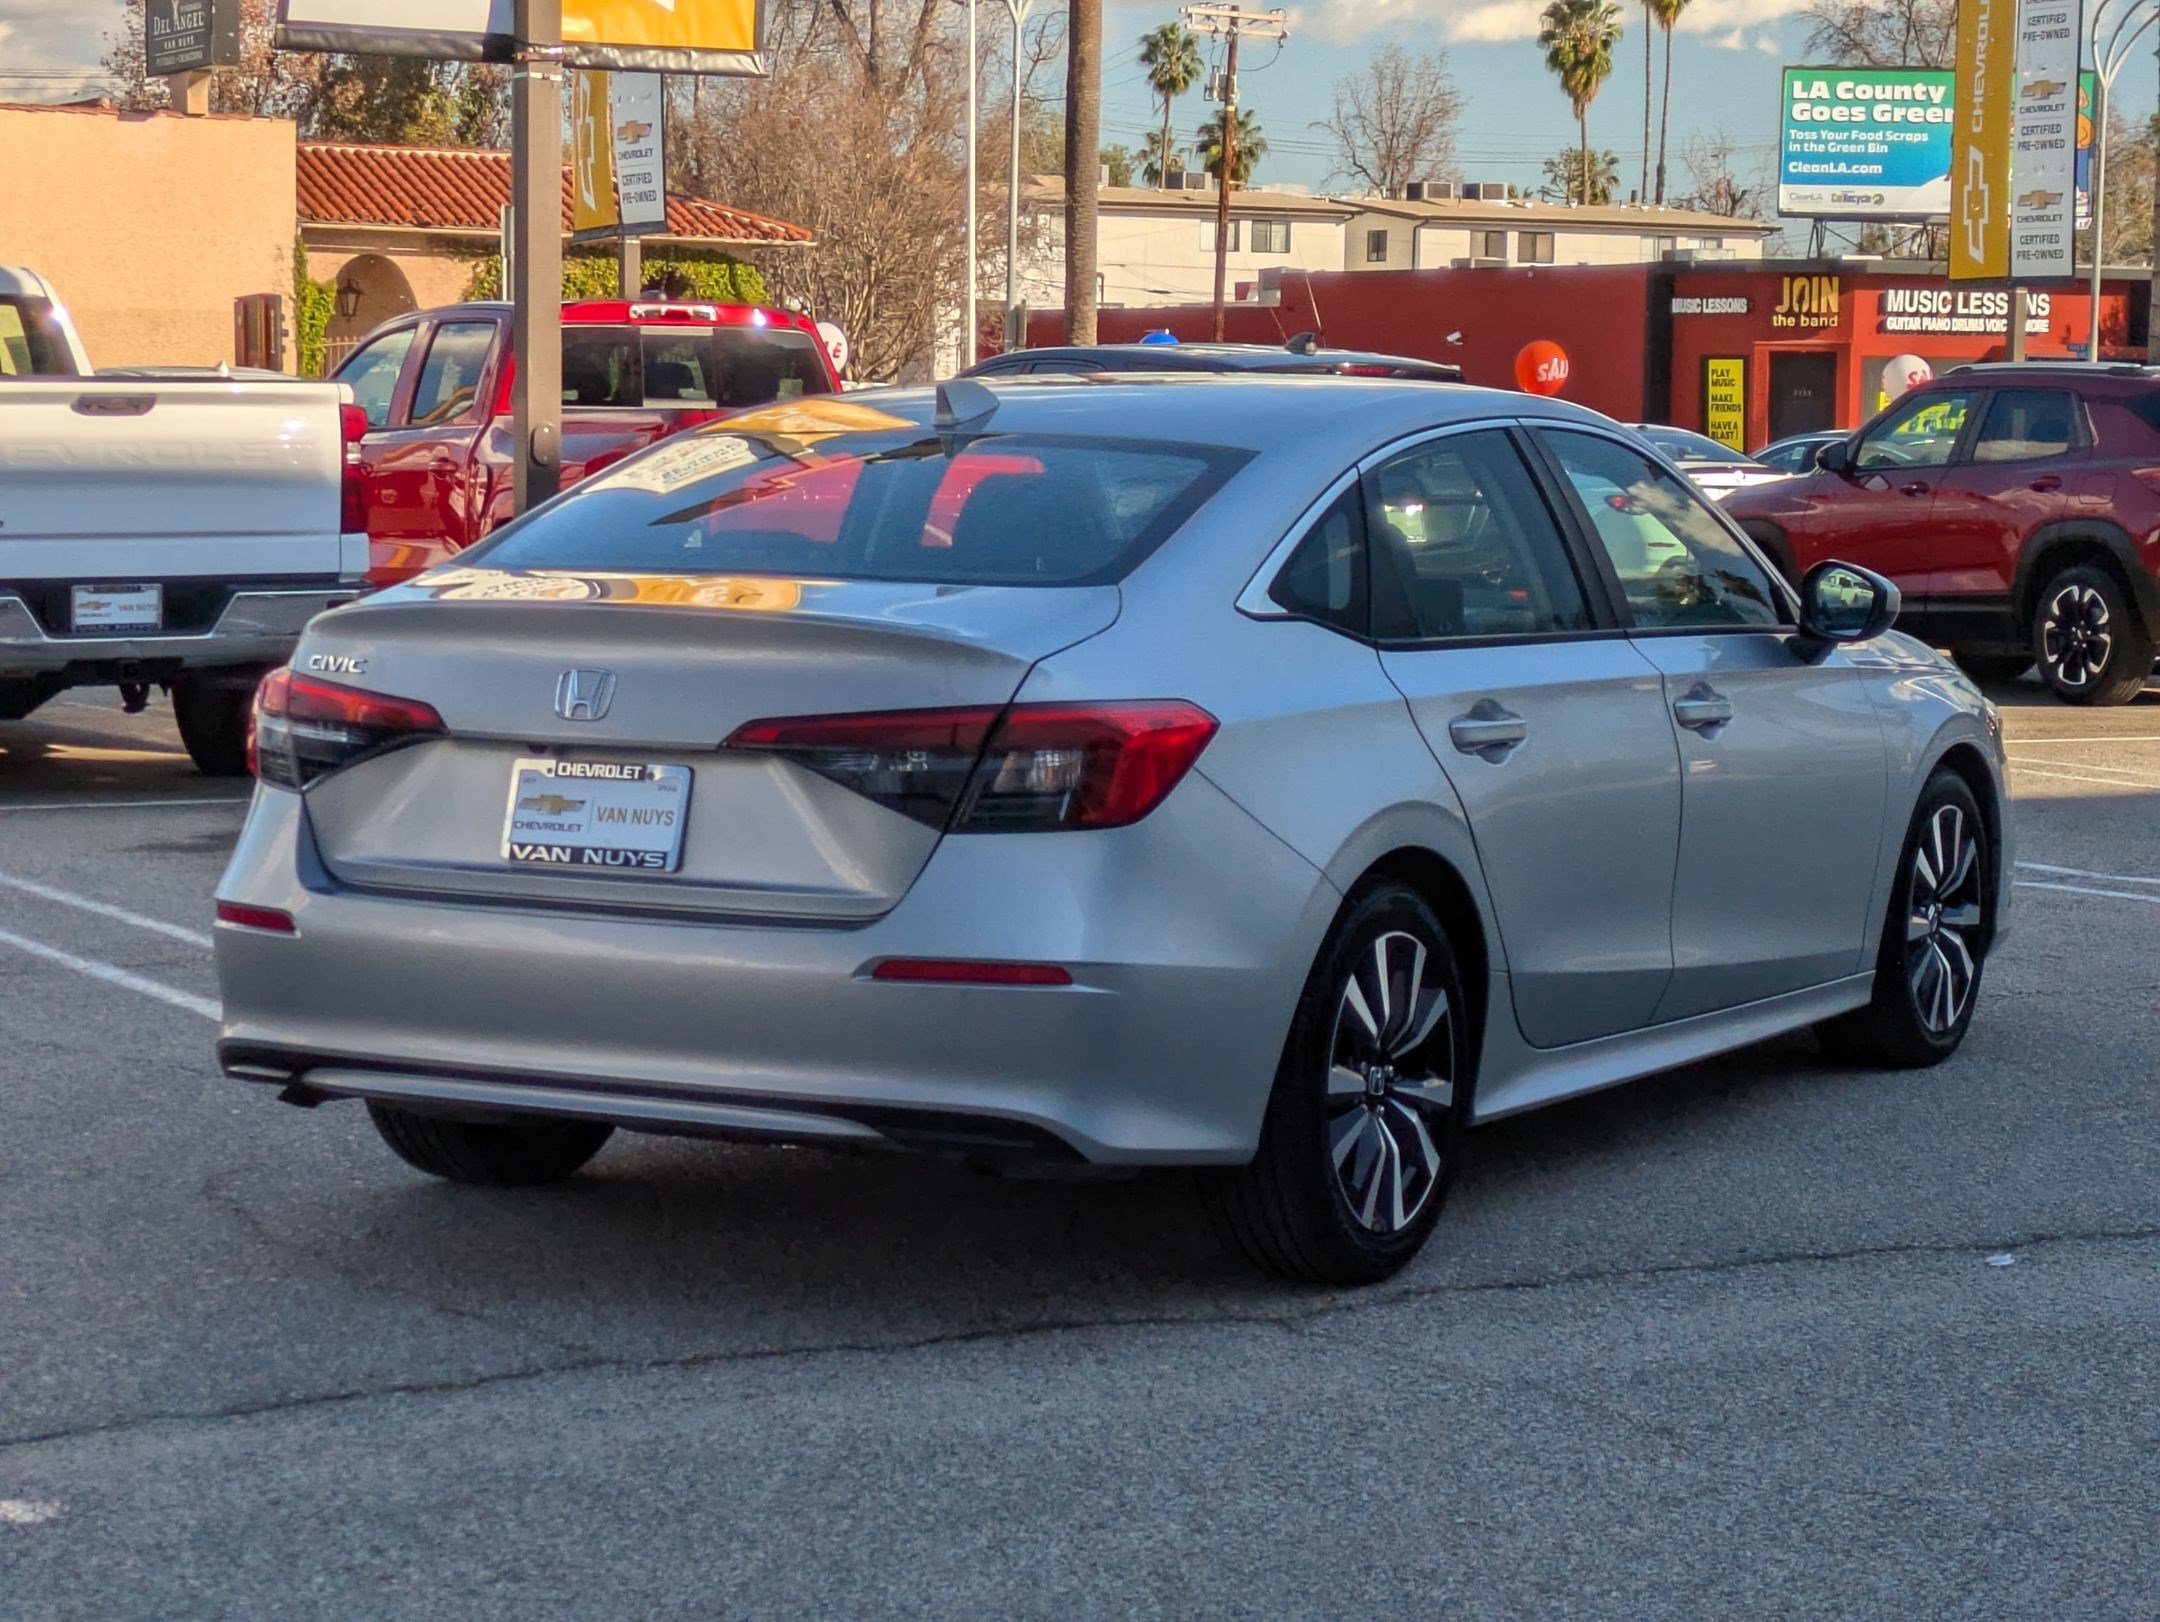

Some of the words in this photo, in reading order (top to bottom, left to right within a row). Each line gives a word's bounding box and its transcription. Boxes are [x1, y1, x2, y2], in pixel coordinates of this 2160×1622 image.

[2028, 13, 2067, 26] CERTIFIED
[2022, 28, 2070, 41] PRE-OWNED
[1793, 81, 1830, 99] LA
[1836, 82, 1946, 104] County
[1791, 103, 1866, 122] Goes
[2019, 103, 2066, 114] CHEVROLET
[2021, 123, 2062, 136] CERTIFIED
[1789, 130, 1818, 140] Toss
[1820, 131, 1849, 141] Your
[1851, 131, 1883, 141] Food
[1886, 131, 1928, 143] Scraps
[1804, 142, 1825, 153] the
[1828, 142, 1865, 153] Green
[1868, 143, 1889, 153] Bin
[2017, 138, 2066, 151] PRE-OWNED
[618, 148, 654, 160] CHEVROLET
[1788, 162, 1883, 174] CleanLA.com
[622, 172, 652, 186] CERTIFIED
[622, 190, 657, 203] PRE-OWNED
[2016, 214, 2064, 223] CHEVROLET
[2019, 234, 2060, 245] CERTIFIED
[2016, 249, 2064, 261] PRE-OWNED
[1775, 276, 1840, 314] JOIN
[1671, 298, 1702, 314] MUSIC
[1702, 298, 1748, 314] LESSONS
[1887, 289, 1952, 314] MUSIC
[1957, 291, 2050, 317] LESSNS
[1773, 315, 1796, 327] the
[1800, 315, 1839, 327] band
[1886, 316, 1921, 331] GUITAR
[1922, 317, 1951, 331] PIANO
[1952, 318, 1985, 332] DRUMS
[1711, 368, 1730, 378] PLAY
[1711, 379, 1736, 387] MUSIC
[1711, 394, 1734, 403] MAKE
[1711, 404, 1742, 413] FRIENDS
[1711, 421, 1733, 430] HAVE
[309, 654, 367, 674] CIVIC
[557, 762, 643, 780] CHEVROLET
[597, 806, 628, 824] VAN
[631, 808, 675, 827] NUYS
[514, 820, 584, 833] CHEVROLET
[512, 844, 572, 864] VAN
[583, 848, 665, 867] NUYS
